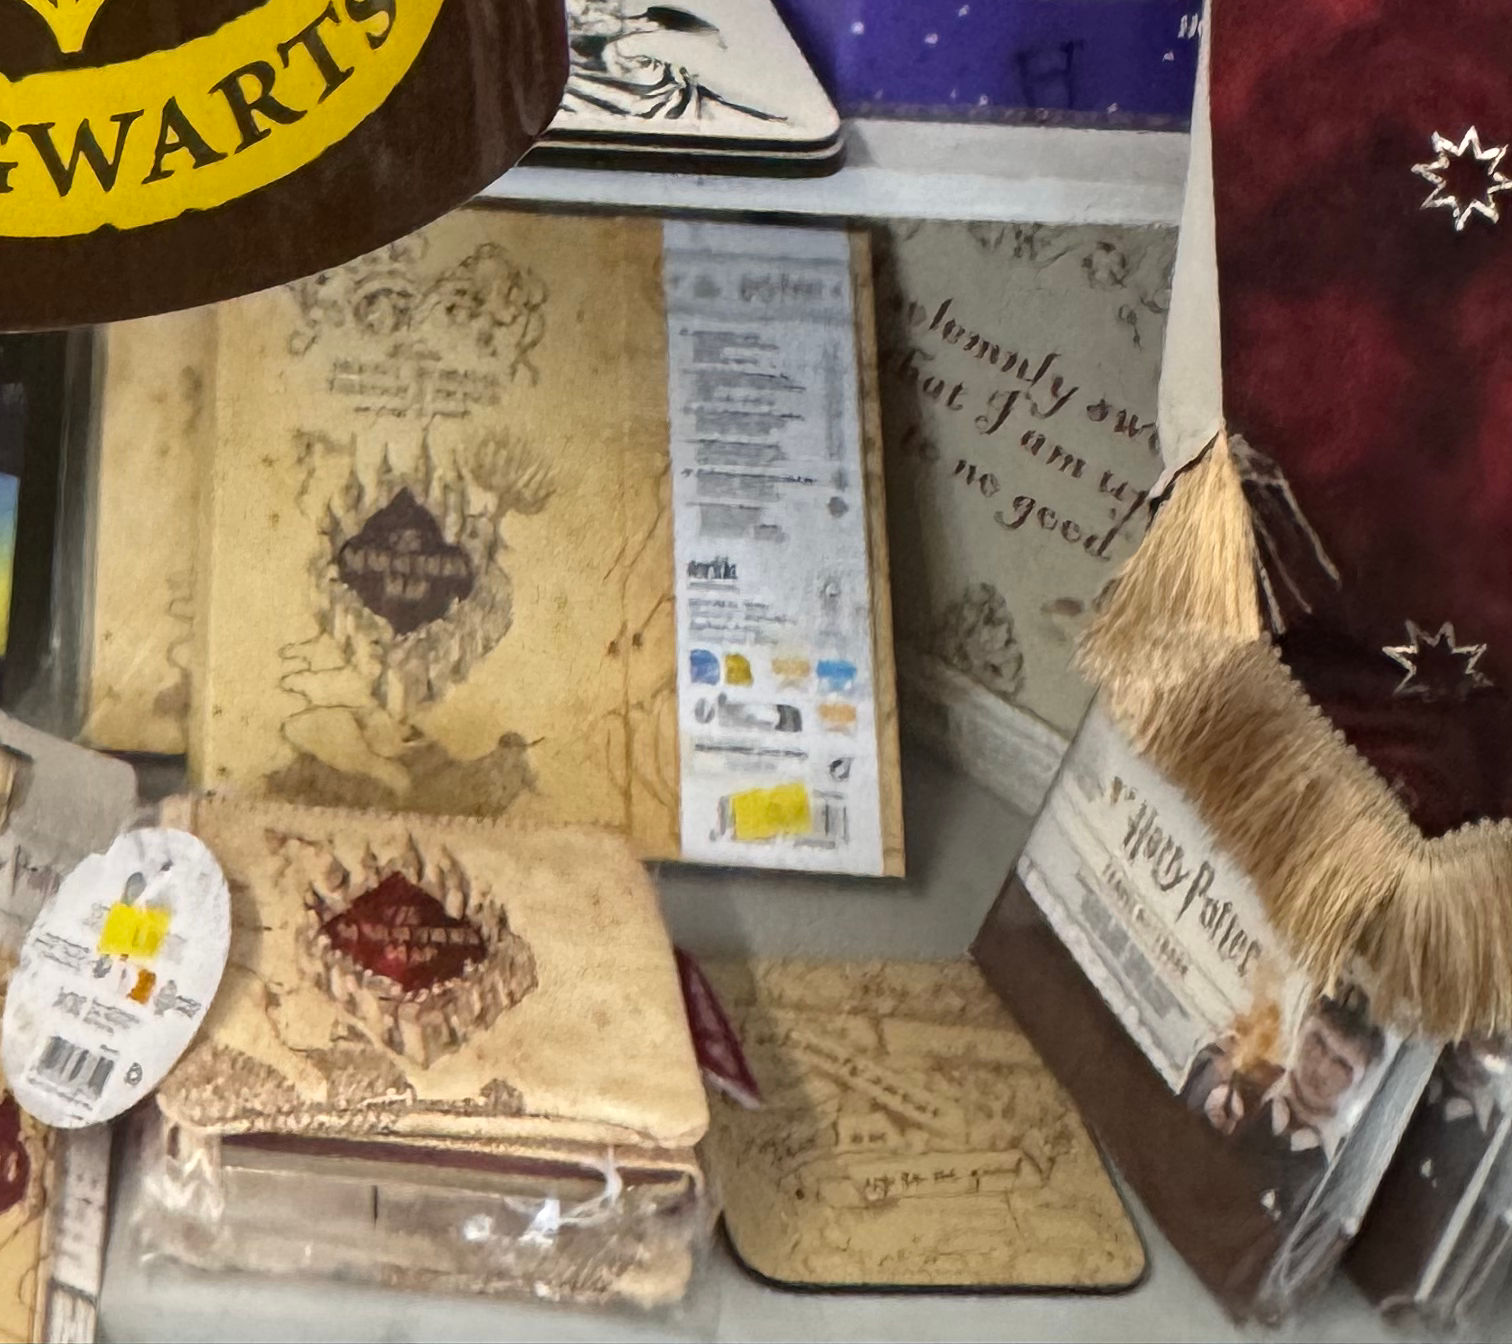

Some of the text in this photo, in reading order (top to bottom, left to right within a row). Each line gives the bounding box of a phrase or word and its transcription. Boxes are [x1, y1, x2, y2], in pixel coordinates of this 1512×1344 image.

[1020, 429, 1087, 480] am
[1123, 799, 1190, 893] Harry
[1175, 860, 1262, 979] Potter
